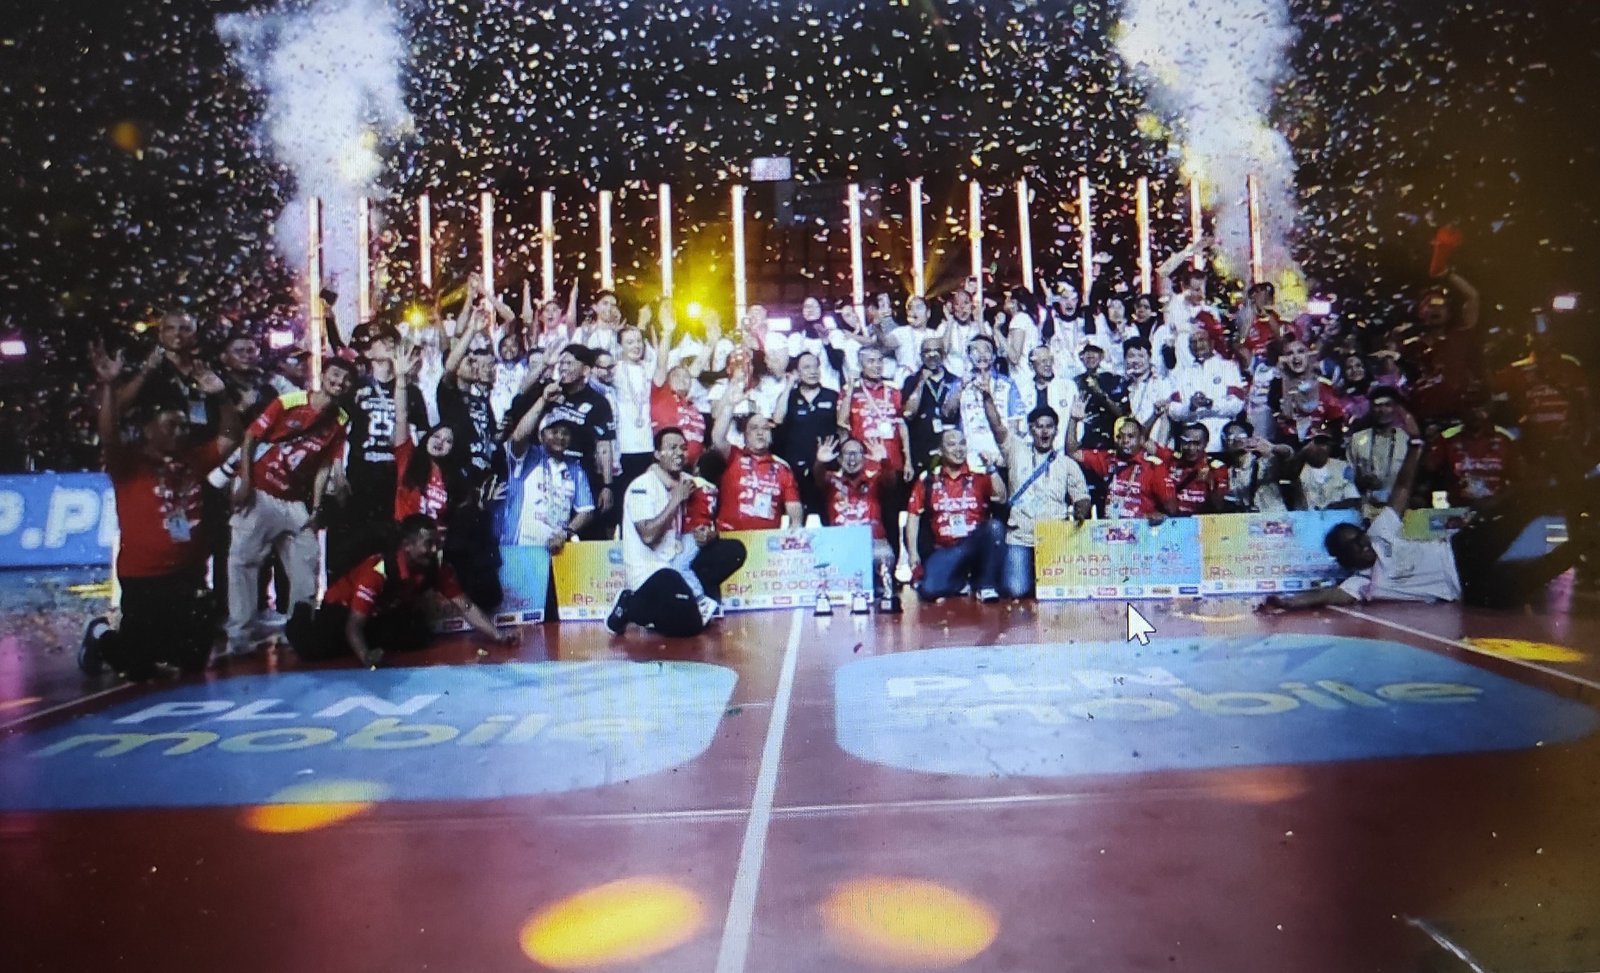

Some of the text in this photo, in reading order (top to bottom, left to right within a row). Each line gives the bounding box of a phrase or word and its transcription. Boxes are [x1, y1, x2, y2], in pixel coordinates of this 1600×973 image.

[887, 665, 1184, 697] PLN
[112, 693, 441, 724] PLN
[30, 712, 662, 758] mobile
